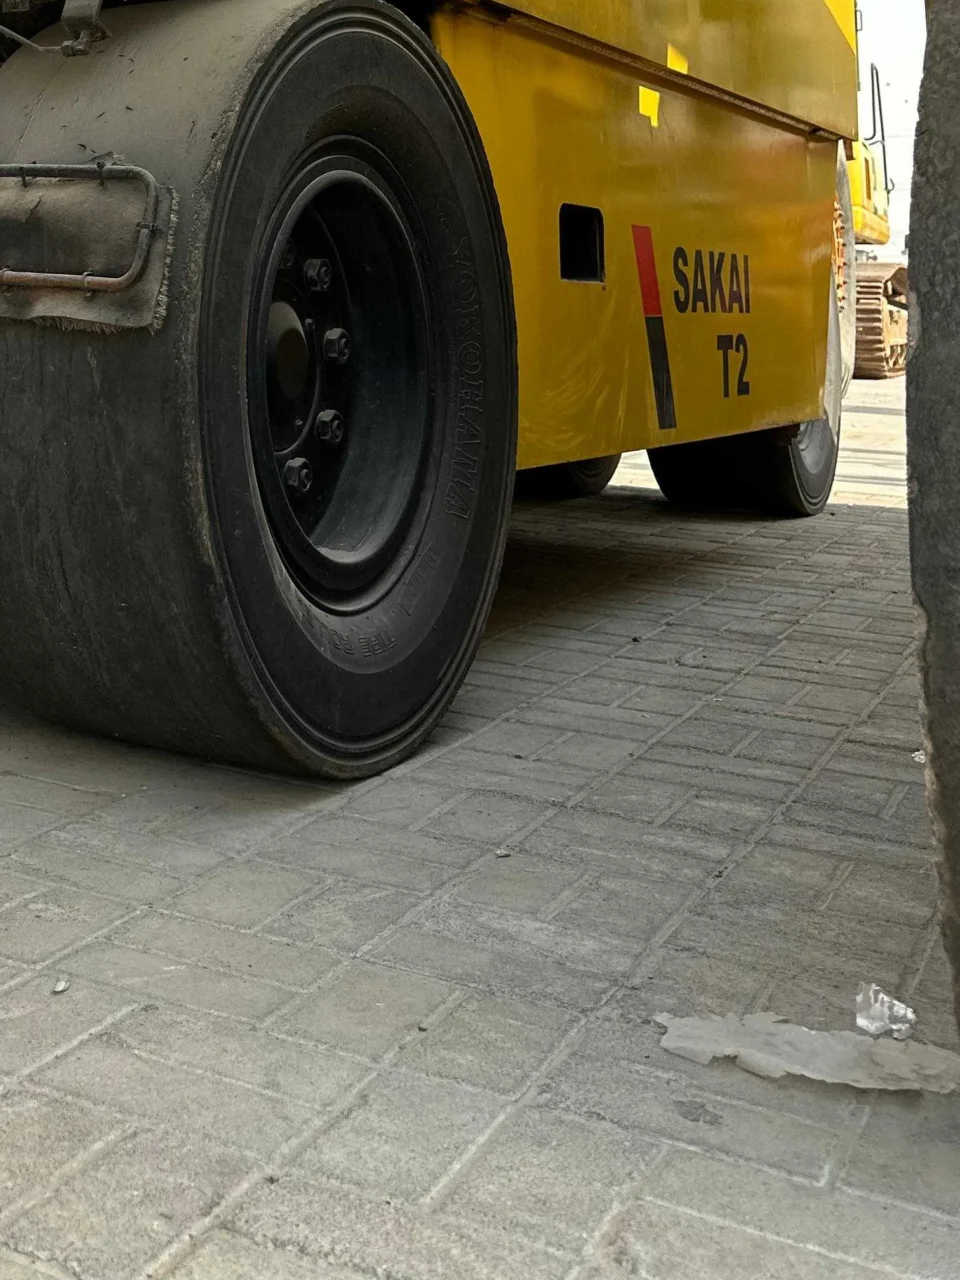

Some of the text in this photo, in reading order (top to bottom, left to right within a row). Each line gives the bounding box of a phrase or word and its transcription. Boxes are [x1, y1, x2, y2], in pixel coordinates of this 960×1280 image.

[673, 247, 750, 314] SAKAI
[444, 236, 483, 520] YOKOHAMA
[717, 333, 749, 398] T2
